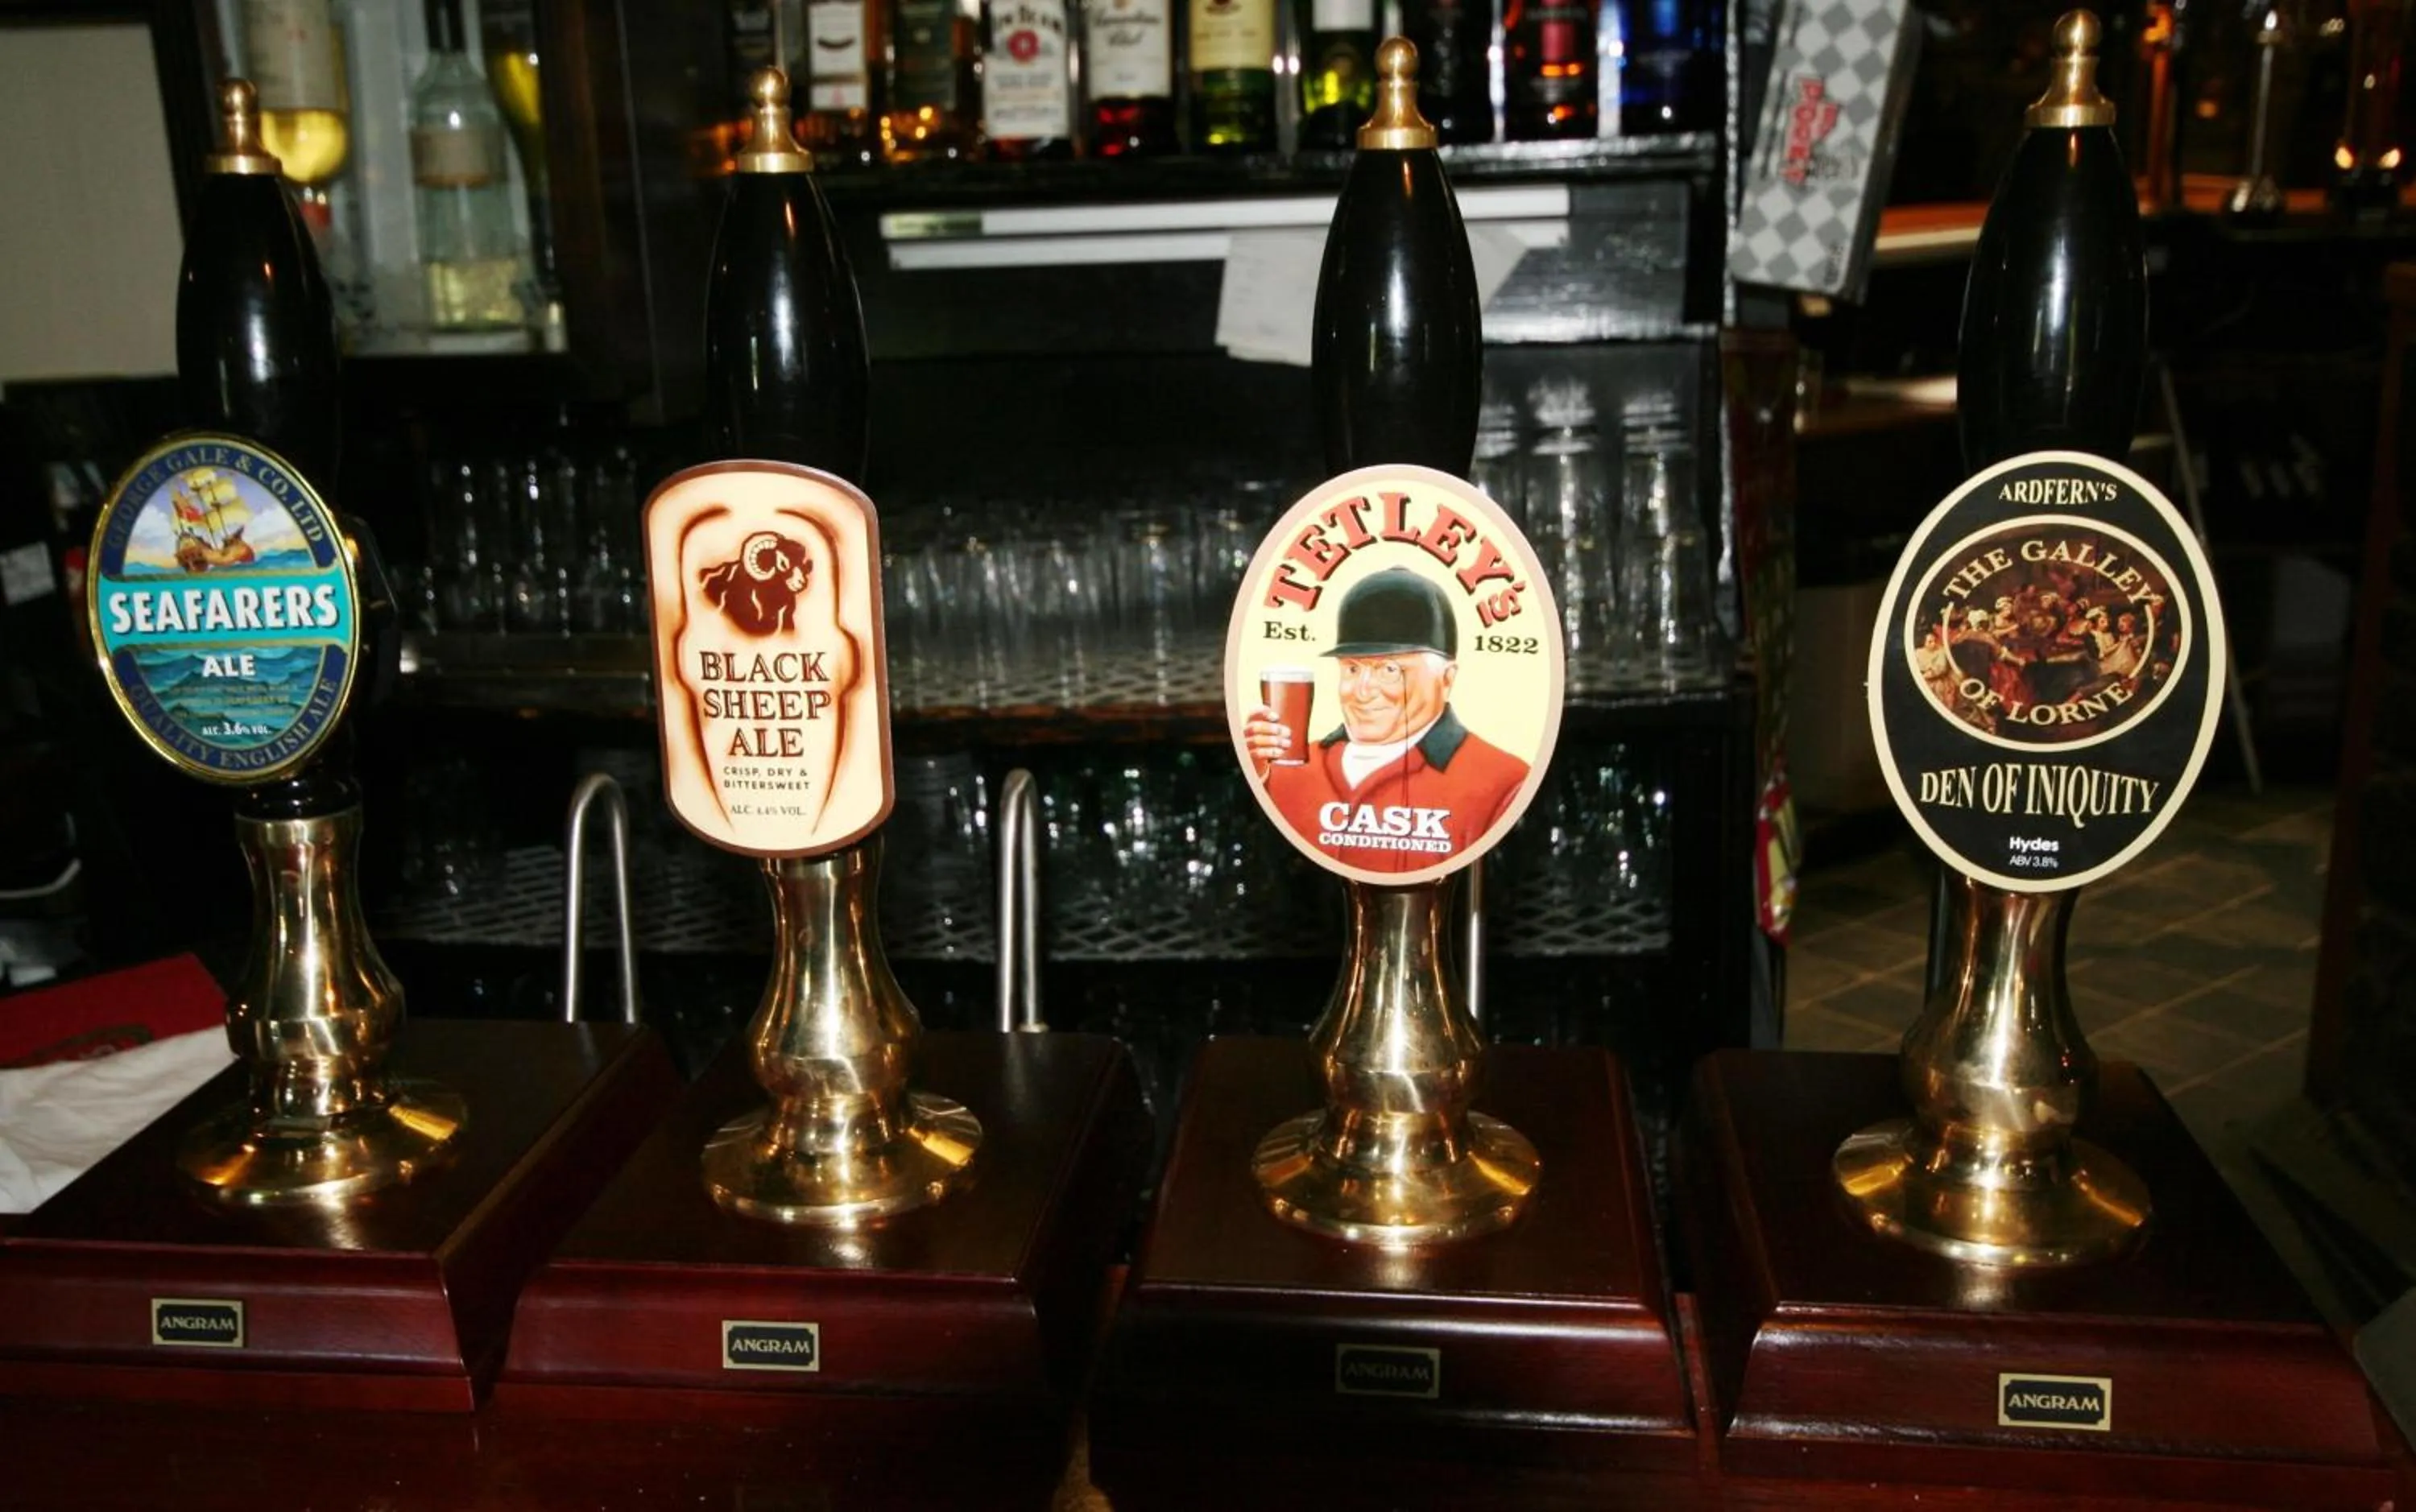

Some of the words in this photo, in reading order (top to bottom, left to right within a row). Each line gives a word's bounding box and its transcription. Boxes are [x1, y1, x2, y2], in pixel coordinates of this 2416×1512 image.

[166, 447, 230, 473] GALE
[234, 454, 252, 473] &
[291, 499, 324, 542] LTD
[1998, 477, 2117, 505] ARDFERN'S
[1942, 547, 2013, 601] THE
[2021, 539, 2153, 606] GALLEY
[109, 584, 340, 634] SEAFARERS
[1263, 620, 1317, 642] Est.
[1475, 635, 1539, 655] 1822
[201, 655, 257, 677] ALE
[699, 651, 830, 683] BLACK
[703, 689, 831, 720] SHEEP
[1959, 677, 2005, 710] OF
[2006, 681, 2133, 725] LORNE
[130, 682, 213, 762] QUALITY
[219, 723, 312, 768] ENGLISH
[314, 680, 337, 722] ALE
[728, 727, 805, 758] ALE
[724, 779, 810, 790] BITTERSWEET
[767, 767, 792, 777] DRY
[800, 768, 808, 777] &
[1920, 766, 1977, 810] DEN
[1982, 762, 2022, 815] OF
[2025, 764, 2160, 828] INIQUITY
[1319, 801, 1450, 839] CASK
[1318, 835, 1452, 853] CONDITIONED
[2009, 837, 2059, 853] Hydes
[2009, 855, 2032, 866] ABV
[161, 1316, 235, 1331] ANGRAM
[731, 1338, 811, 1354] ANGRAM
[2009, 1393, 2100, 1411] ANGRAM
